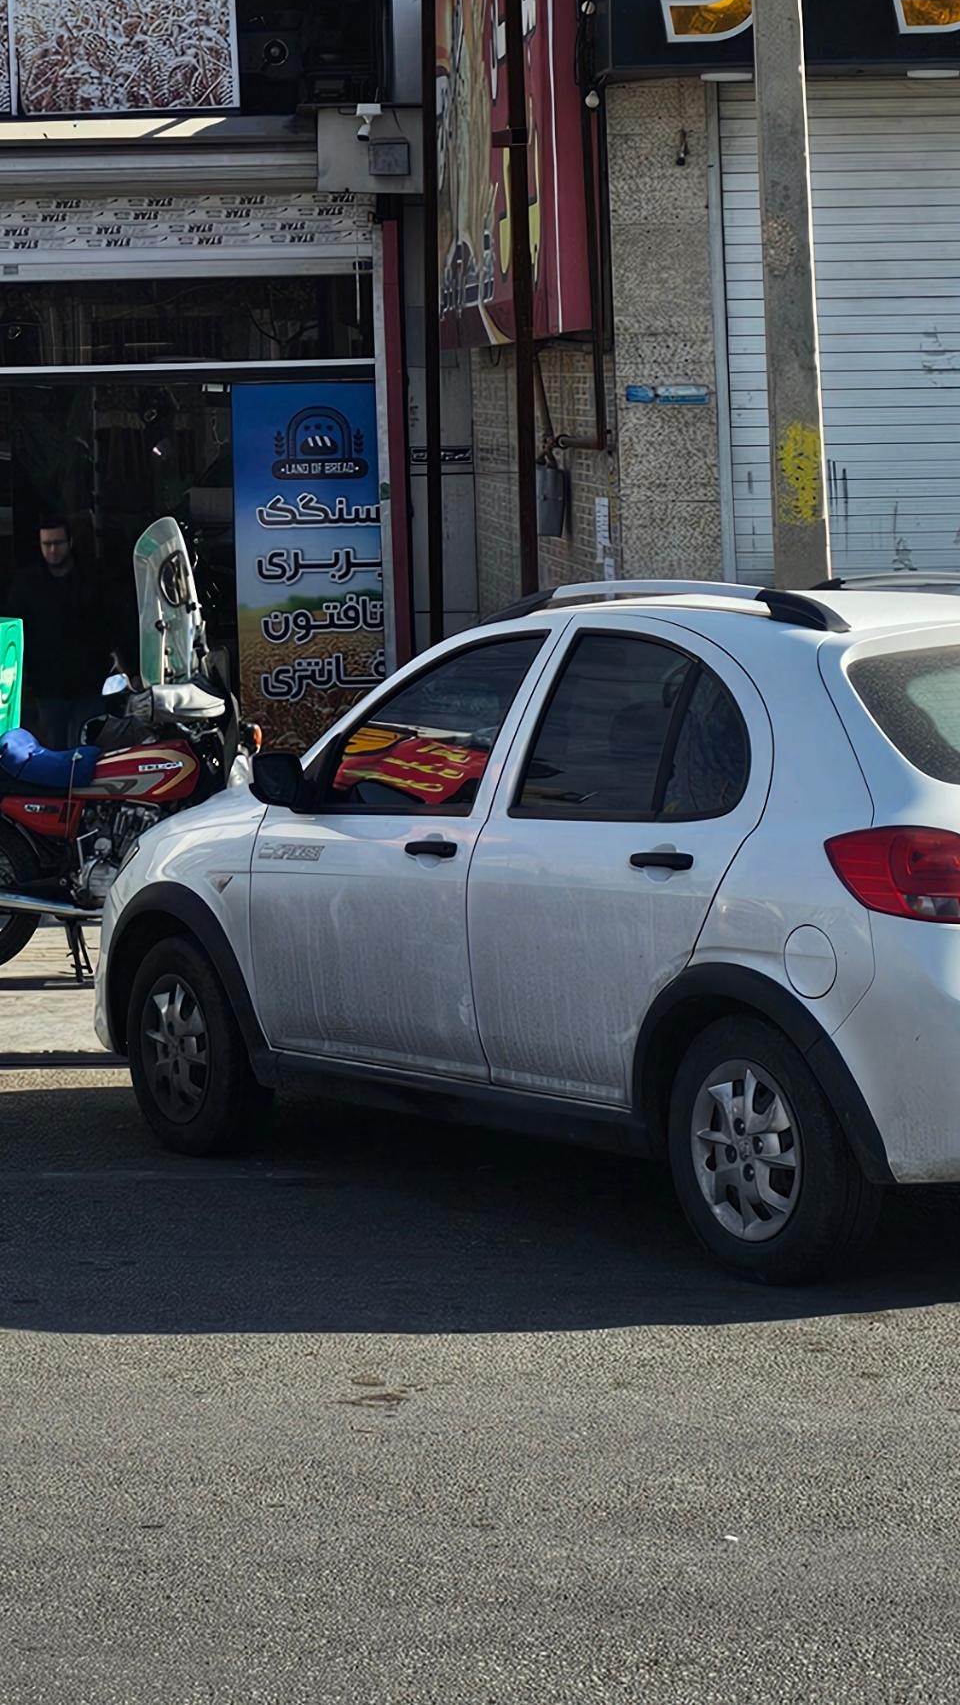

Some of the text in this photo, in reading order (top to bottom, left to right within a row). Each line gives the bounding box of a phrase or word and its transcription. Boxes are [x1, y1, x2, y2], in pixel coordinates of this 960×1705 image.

[55, 199, 81, 209] STAR
[147, 197, 173, 207] STAR
[239, 195, 266, 205] STAR
[133, 211, 159, 220] STAR
[225, 209, 251, 218] STAR
[317, 206, 344, 216] STAR
[41, 213, 67, 223] STAR
[96, 225, 122, 235] STAR
[188, 223, 214, 233] STAR
[280, 221, 306, 231] STAR
[3, 227, 30, 237] STAR
[105, 238, 131, 247] STAR
[197, 236, 223, 245] STAR
[290, 233, 315, 243] STAR
[12, 240, 39, 249] STAR
[286, 463, 309, 474] LAND
[311, 463, 322, 474] OF
[256, 493, 381, 528] سنگک
